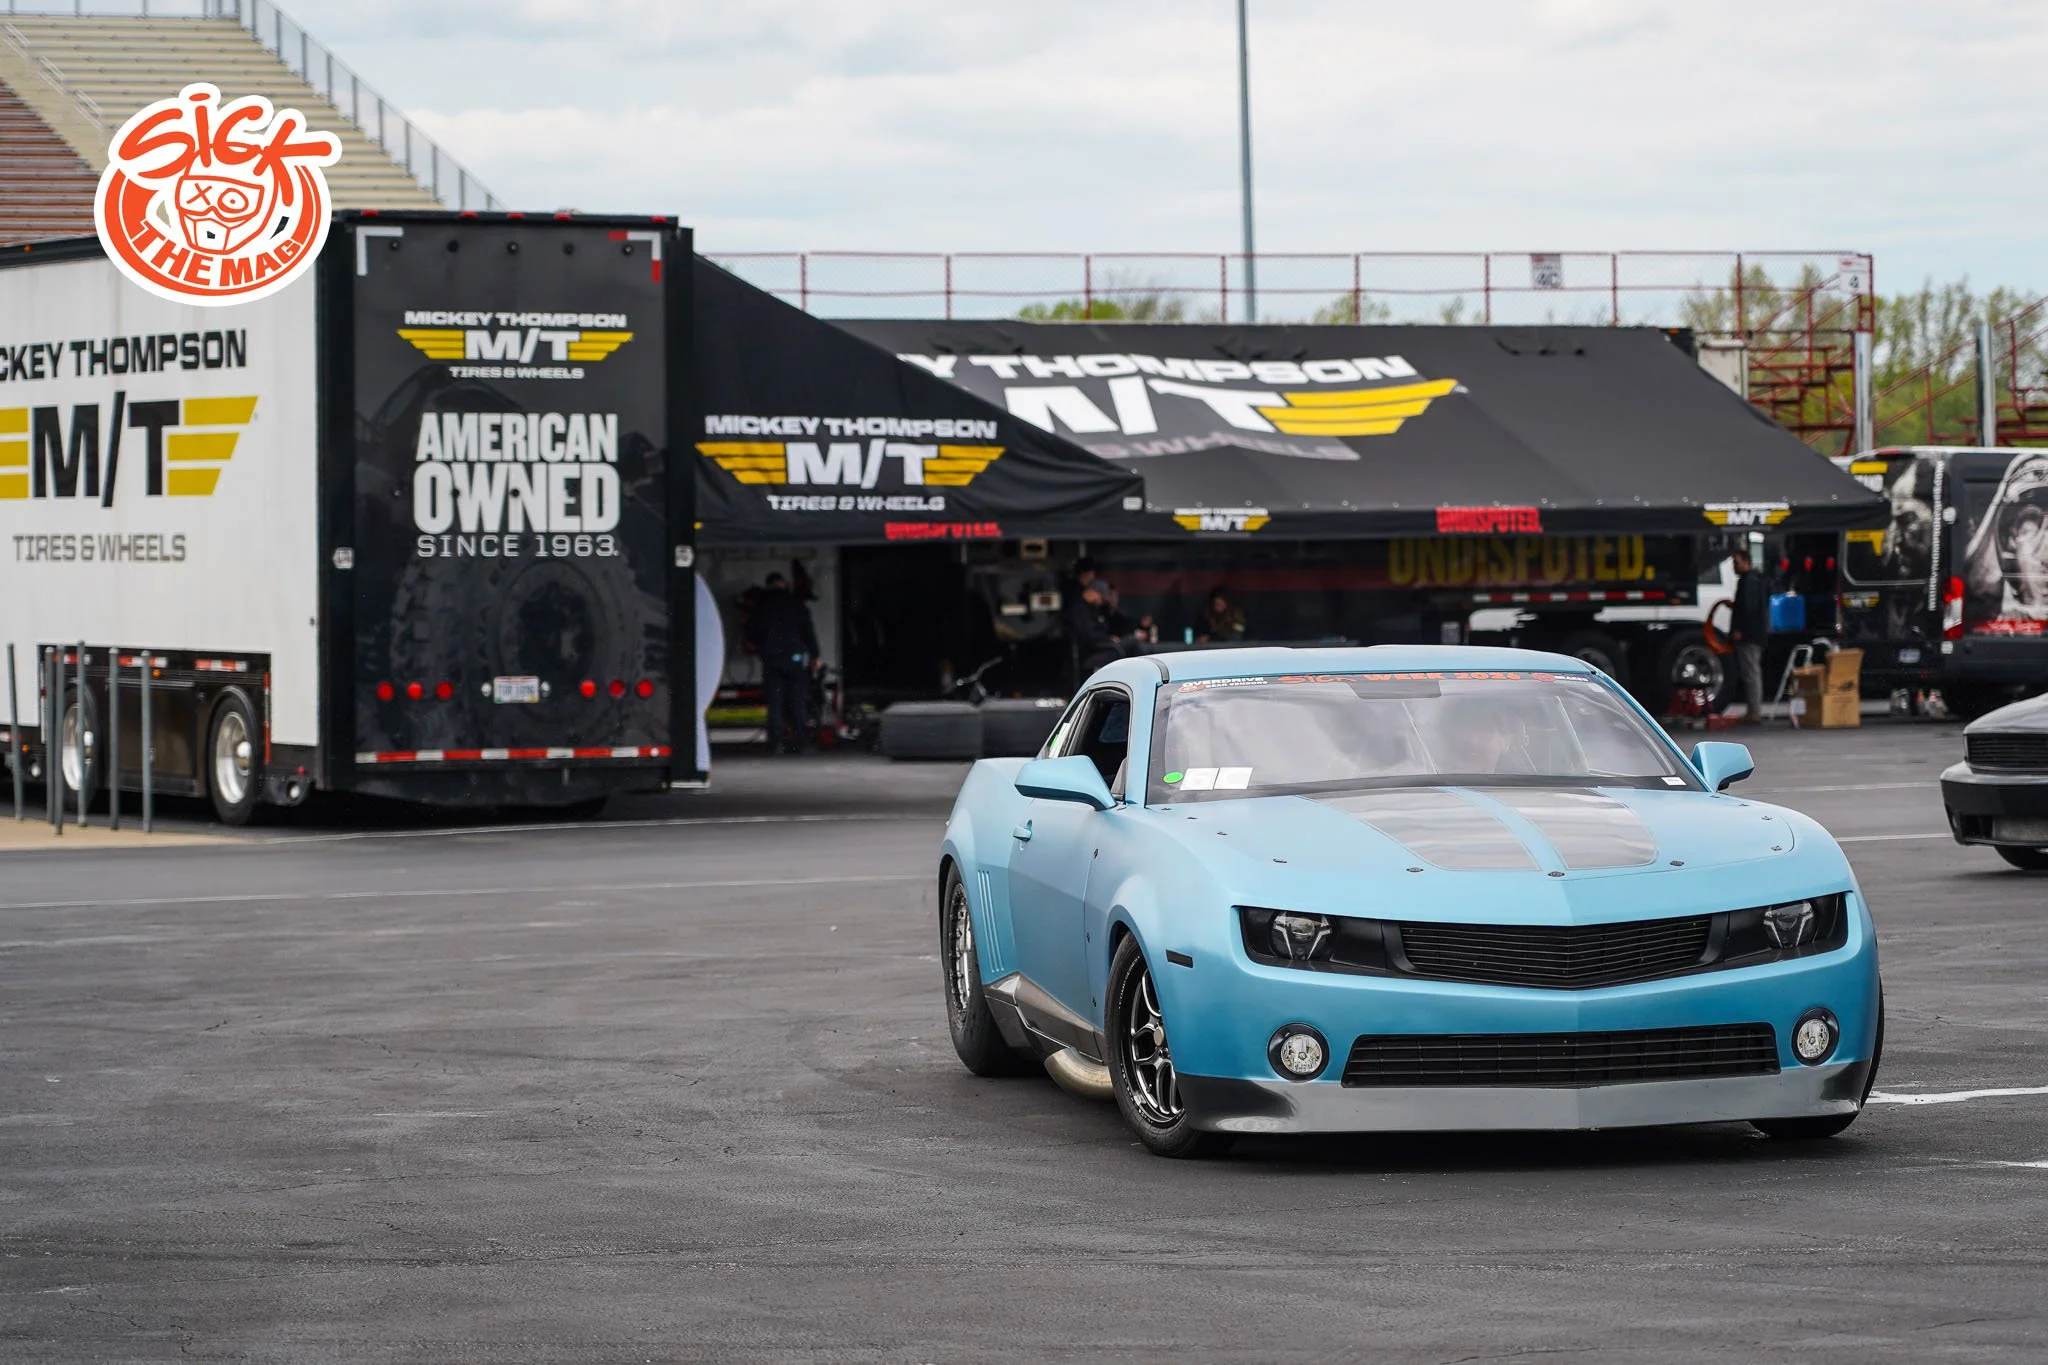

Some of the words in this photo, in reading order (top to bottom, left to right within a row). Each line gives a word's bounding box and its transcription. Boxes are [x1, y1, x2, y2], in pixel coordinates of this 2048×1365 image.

[404, 310, 493, 326] MICKEY
[495, 312, 627, 328] THOMPSON
[69, 329, 246, 377] THOMPSON
[465, 327, 581, 363] M/T
[449, 366, 503, 379] TIRES
[516, 367, 585, 379] WHEELS
[968, 353, 1418, 384] THOMPSON
[415, 411, 618, 462] AMERICAN
[705, 415, 820, 435] MICKEY
[822, 417, 998, 439] THOMPSON
[32, 389, 180, 509] M/T
[785, 438, 939, 489] M/T
[413, 461, 620, 535] OWNED
[767, 495, 836, 511] TIRES
[856, 496, 946, 511] WHEELS
[13, 532, 77, 563] TIRES
[98, 532, 187, 562] WHEELS
[417, 534, 520, 557] SINCE
[535, 534, 619, 557] 1963.
[1182, 677, 1264, 687] OVERDRIVE
[1363, 672, 1446, 681] WEEK
